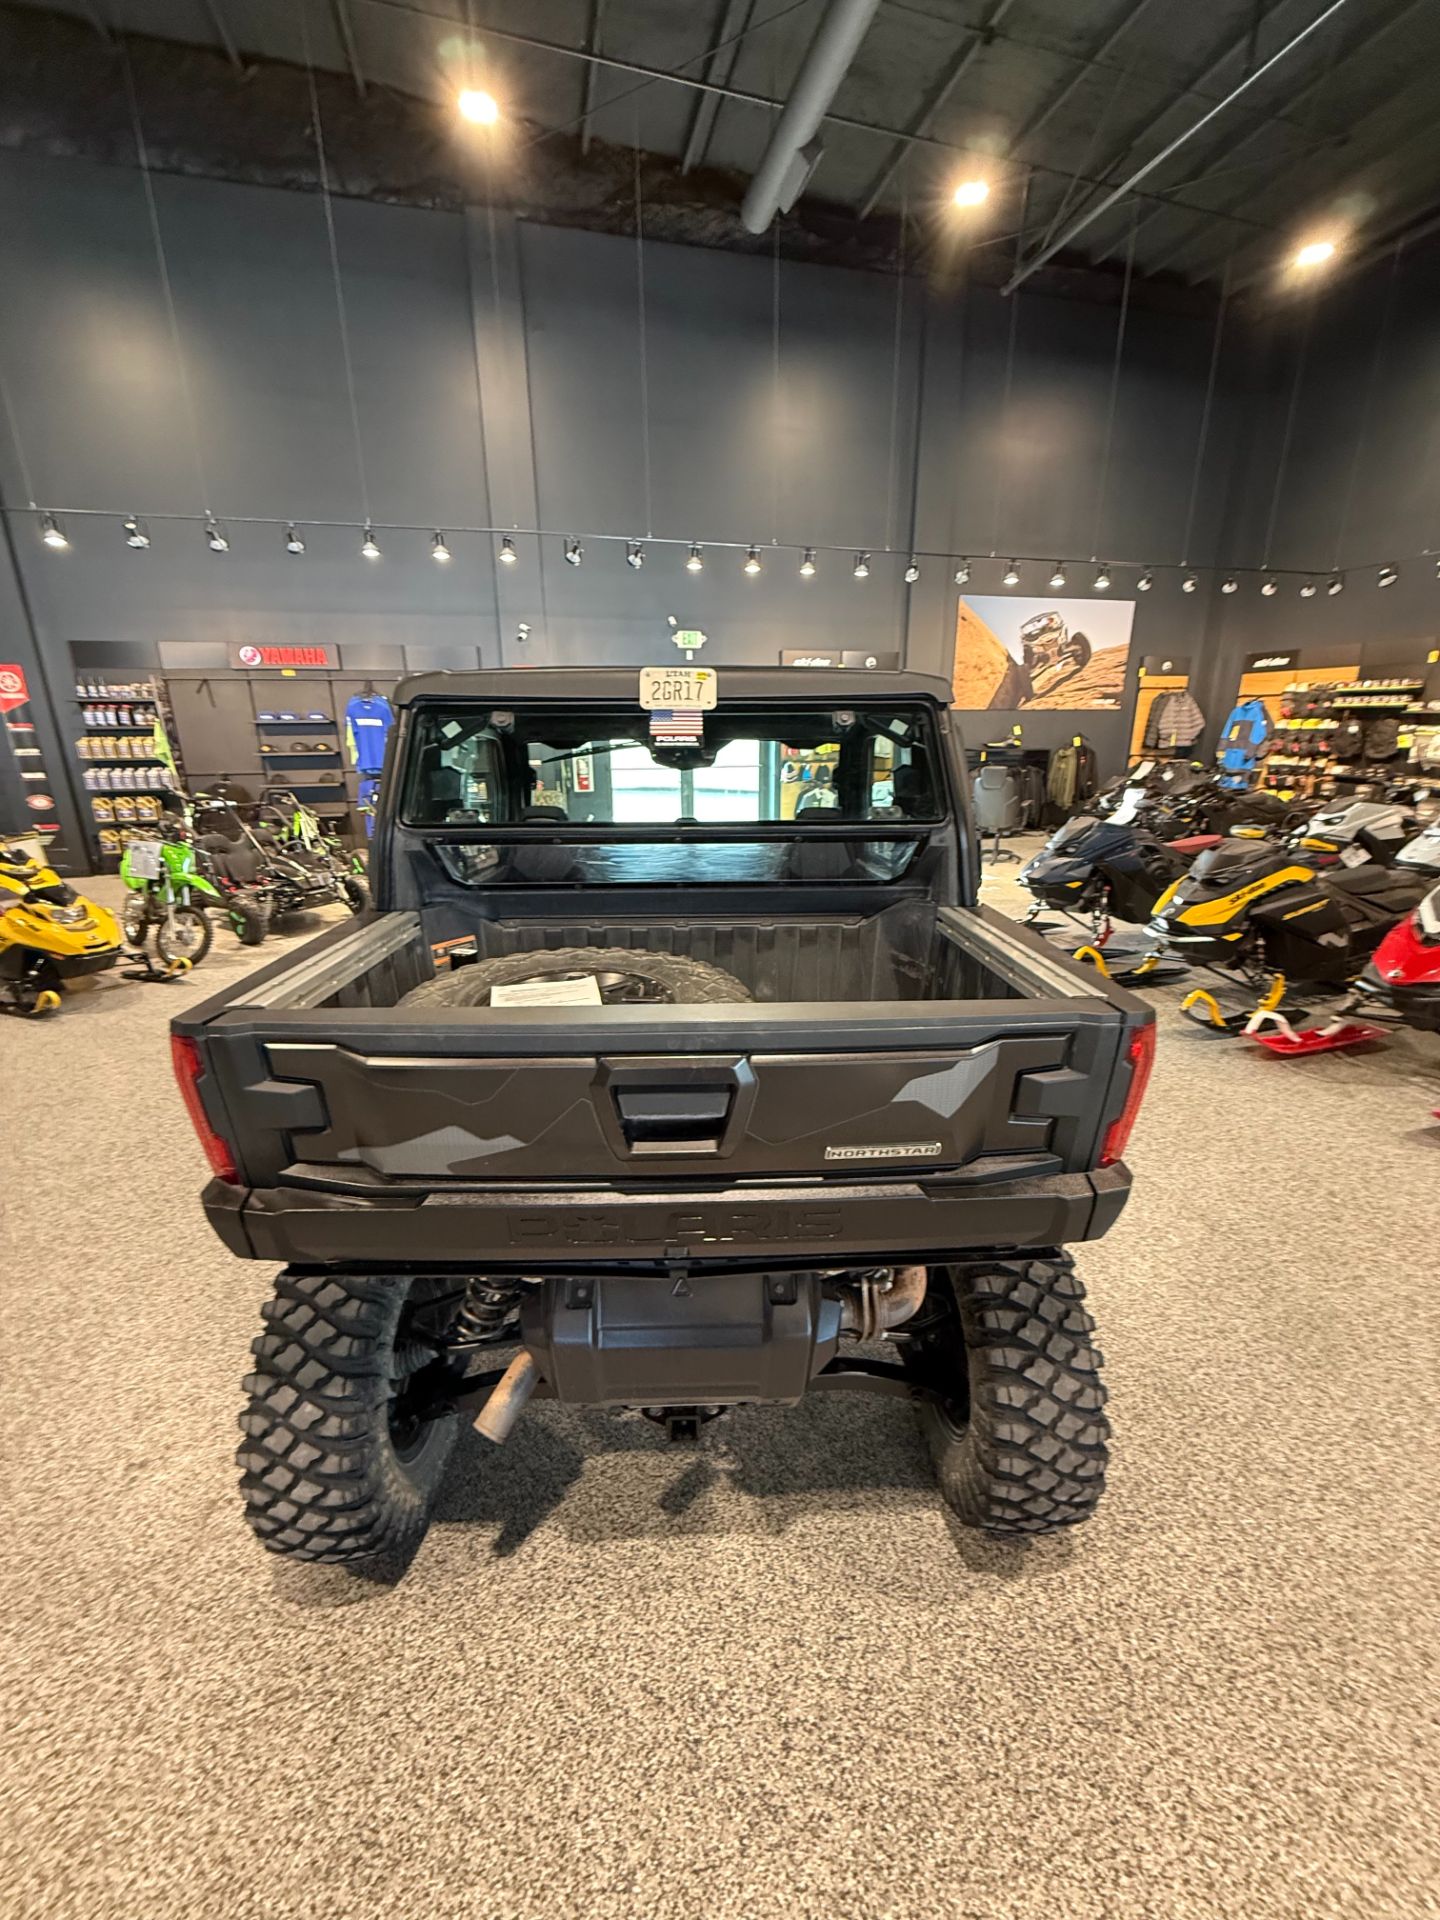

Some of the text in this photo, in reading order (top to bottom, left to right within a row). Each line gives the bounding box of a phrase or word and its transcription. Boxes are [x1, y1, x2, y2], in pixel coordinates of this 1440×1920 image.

[258, 647, 328, 665] YAMAHA
[652, 680, 704, 701] 2GR17
[832, 1147, 934, 1157] NORTHSTAR
[507, 1209, 843, 1244] POLARIS
